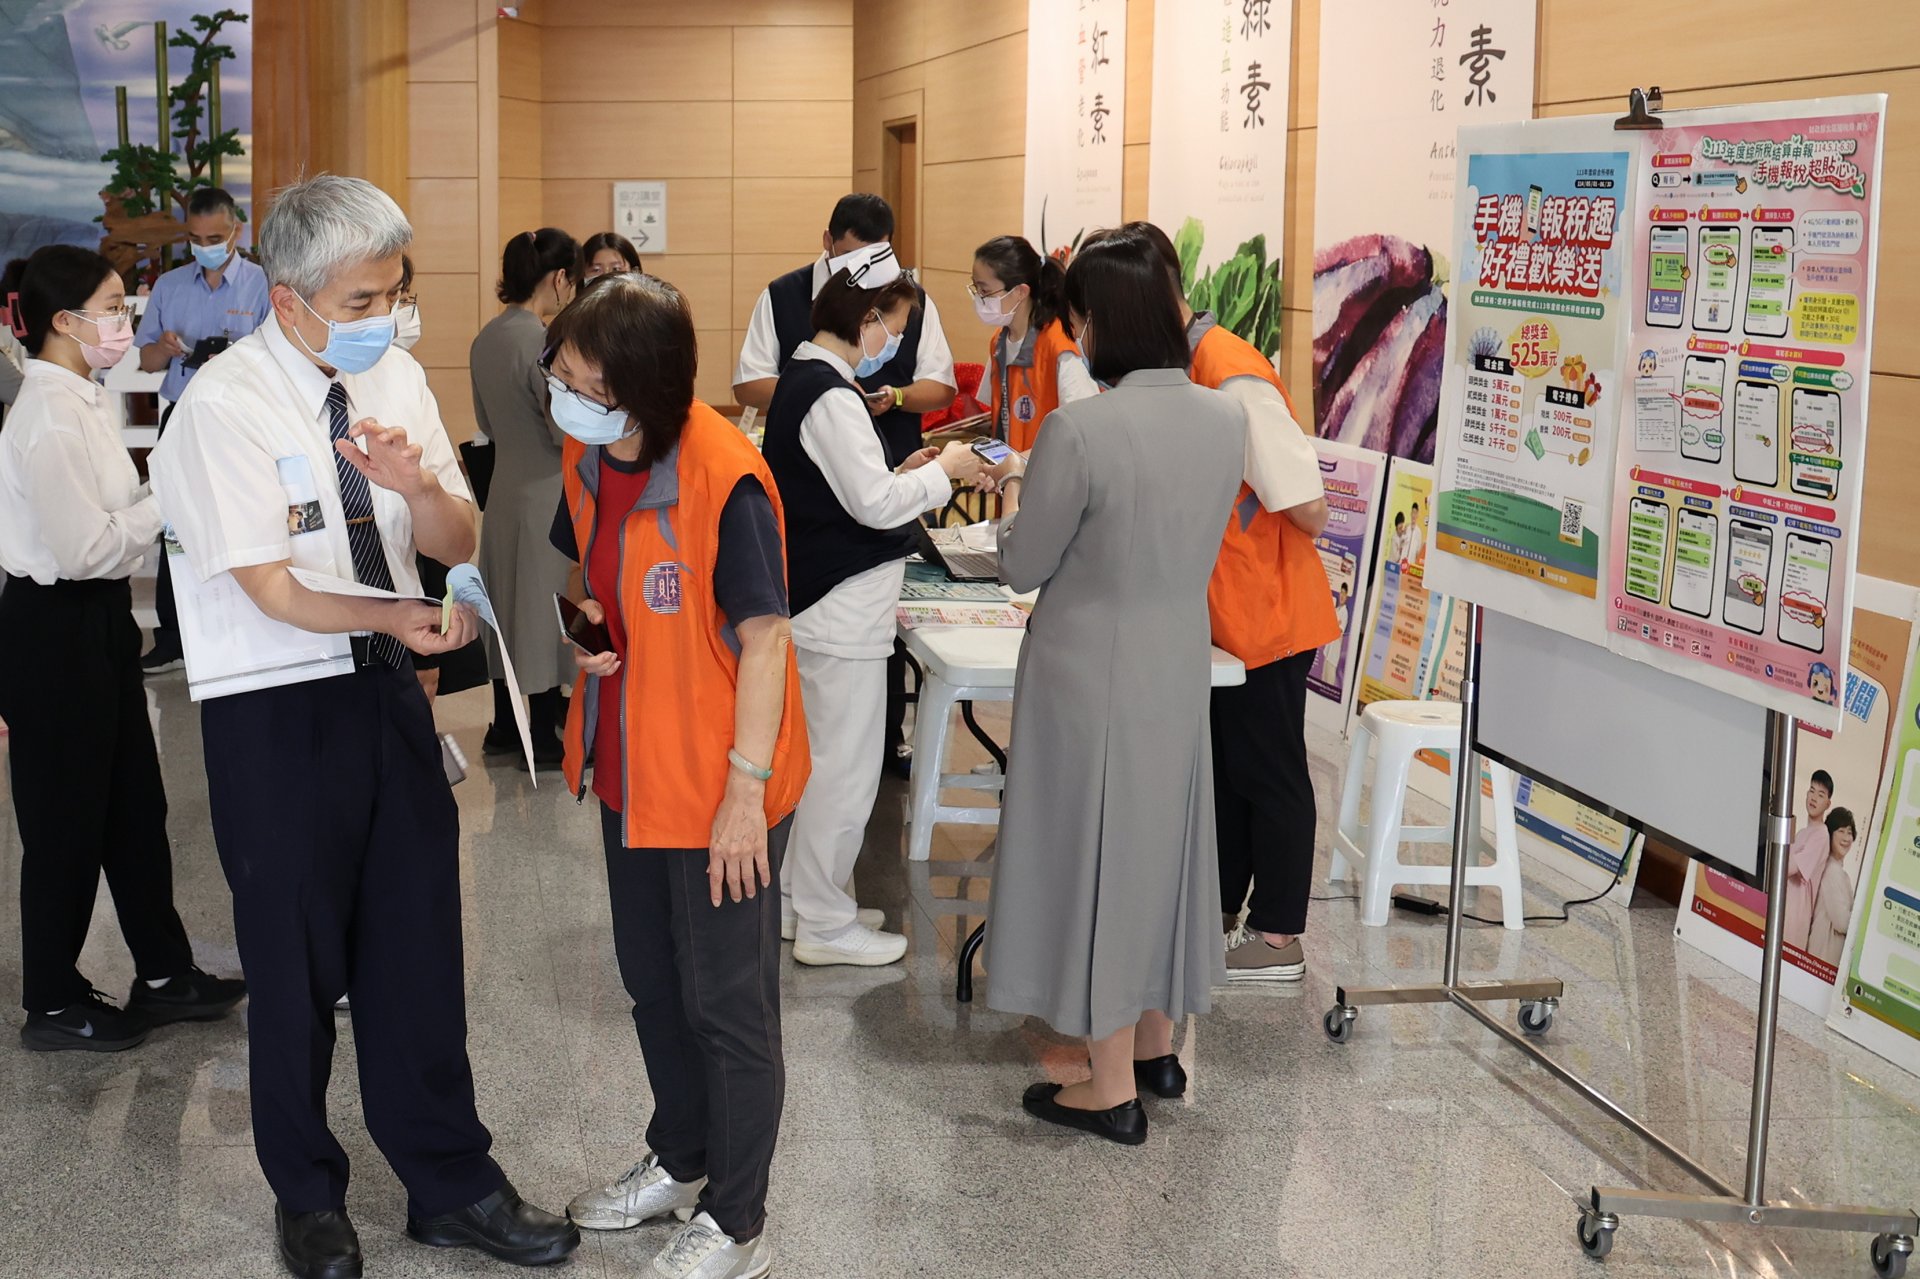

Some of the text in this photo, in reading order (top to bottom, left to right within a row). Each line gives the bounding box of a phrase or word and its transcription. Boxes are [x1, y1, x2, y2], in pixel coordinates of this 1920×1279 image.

[1430, 0, 1449, 112] 力退化
[1090, 0, 1110, 145] 紅素
[1481, 242, 1602, 290] 好禮歡樂送
[1521, 324, 1549, 340] 總獎金
[1552, 425, 1572, 440] 200元
[1553, 410, 1573, 424] 500元
